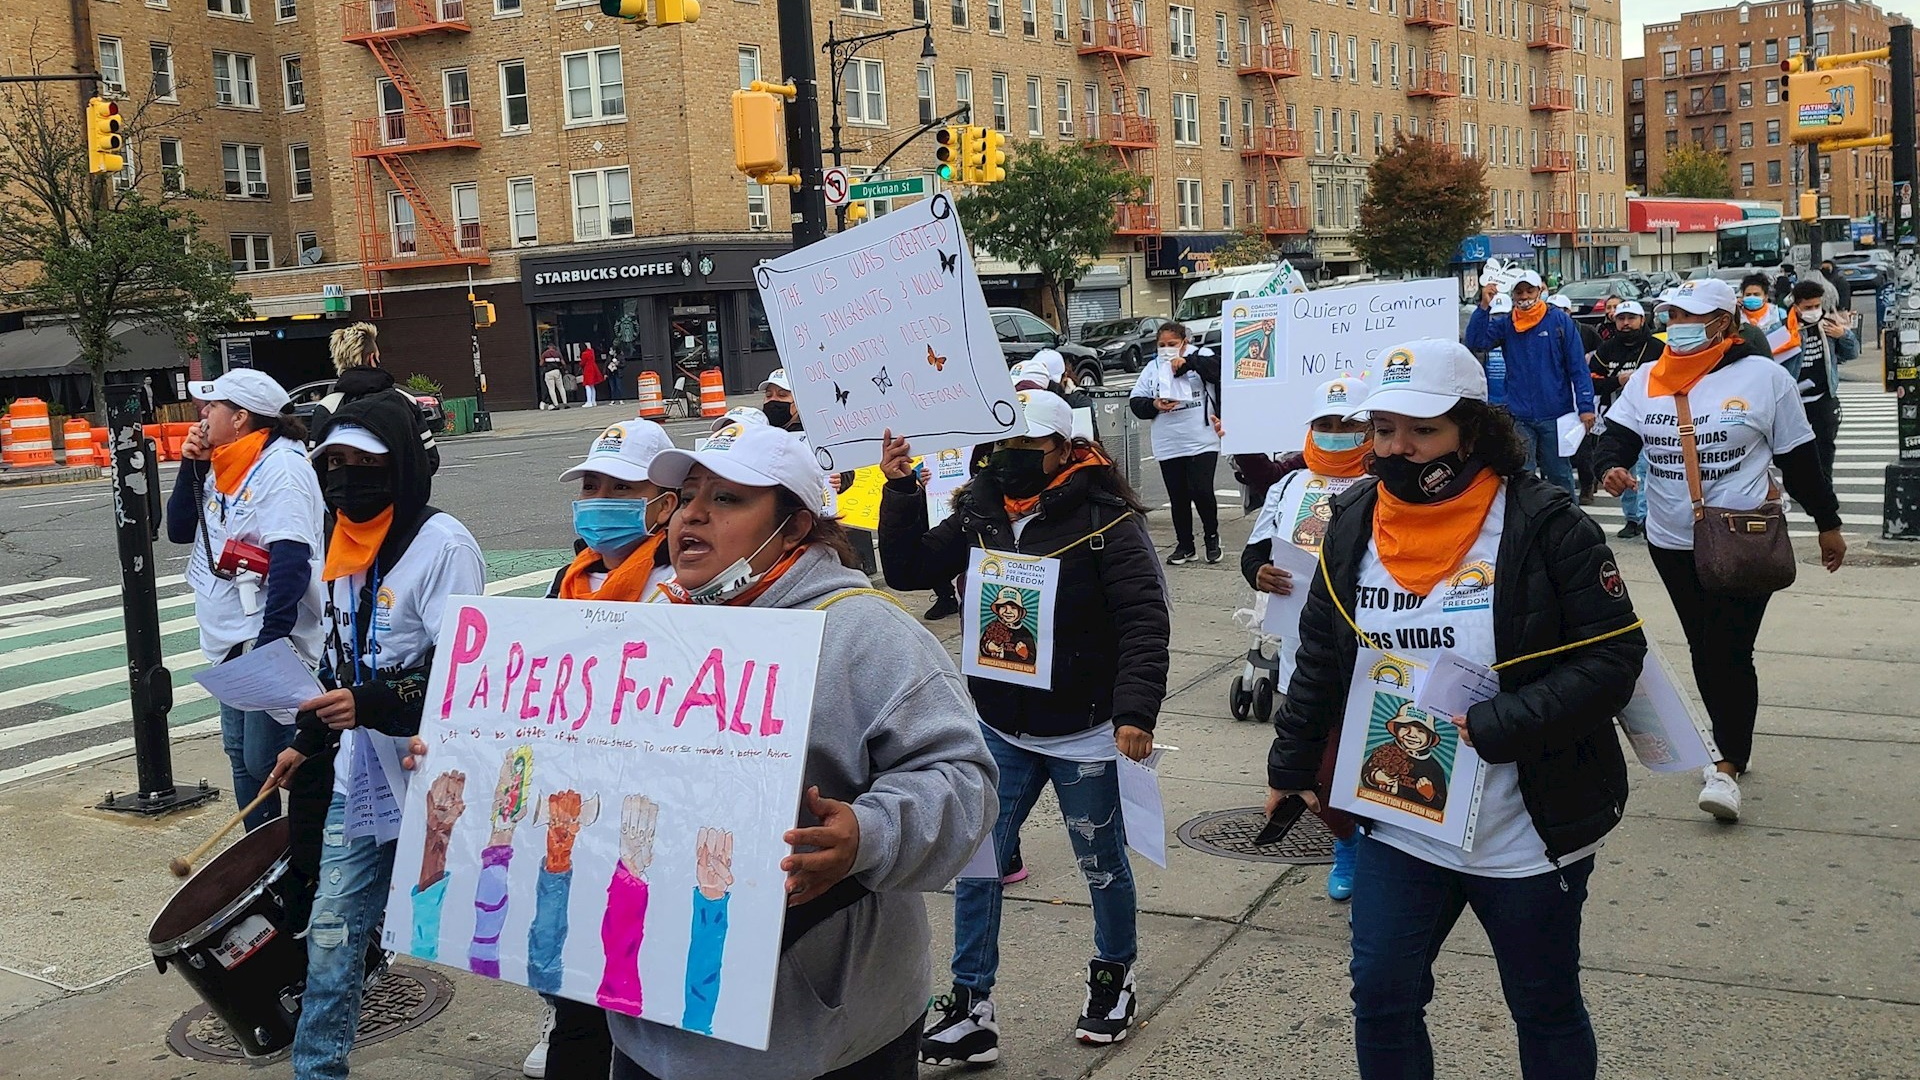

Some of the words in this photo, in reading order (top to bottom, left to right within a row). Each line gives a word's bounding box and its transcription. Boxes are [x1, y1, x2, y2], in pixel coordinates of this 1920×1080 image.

[862, 183, 899, 198] Dyckman
[901, 182, 910, 192] St
[535, 267, 618, 285] STARBUCKS
[620, 262, 674, 278] COFFEE
[780, 283, 803, 311] THE
[811, 267, 838, 295] U.S
[848, 247, 885, 279] WAS
[888, 220, 947, 261] CREATED
[793, 321, 812, 349] BY
[820, 288, 893, 336] IMIGRANTS
[911, 265, 944, 297] NOW
[1293, 297, 1358, 319] Quiero
[1369, 295, 1447, 314] Caminar
[1332, 321, 1351, 334] EN
[1365, 316, 1397, 332] LUZ
[805, 361, 831, 383] OUR
[831, 333, 889, 373] COUNTRY
[899, 313, 951, 346] NEEDS
[1302, 352, 1326, 376] NO
[1334, 352, 1354, 370] En
[1239, 370, 1265, 378] HUMAN
[816, 401, 899, 439] IMIGRATION
[901, 371, 971, 410] REFORM
[1645, 413, 1679, 426] RESPE
[1695, 430, 1727, 445] VIDAS
[1698, 445, 1746, 464] ERECHOS
[1007, 562, 1046, 573] COALITION
[1005, 575, 1045, 586] FREEDOM
[1445, 587, 1489, 596] COALITION
[1443, 597, 1489, 606] FREEDOM
[1395, 626, 1456, 649] VIDAS
[440, 606, 598, 731] PAPERS
[673, 648, 784, 737] ALL
[1401, 801, 1425, 815] REFORM
